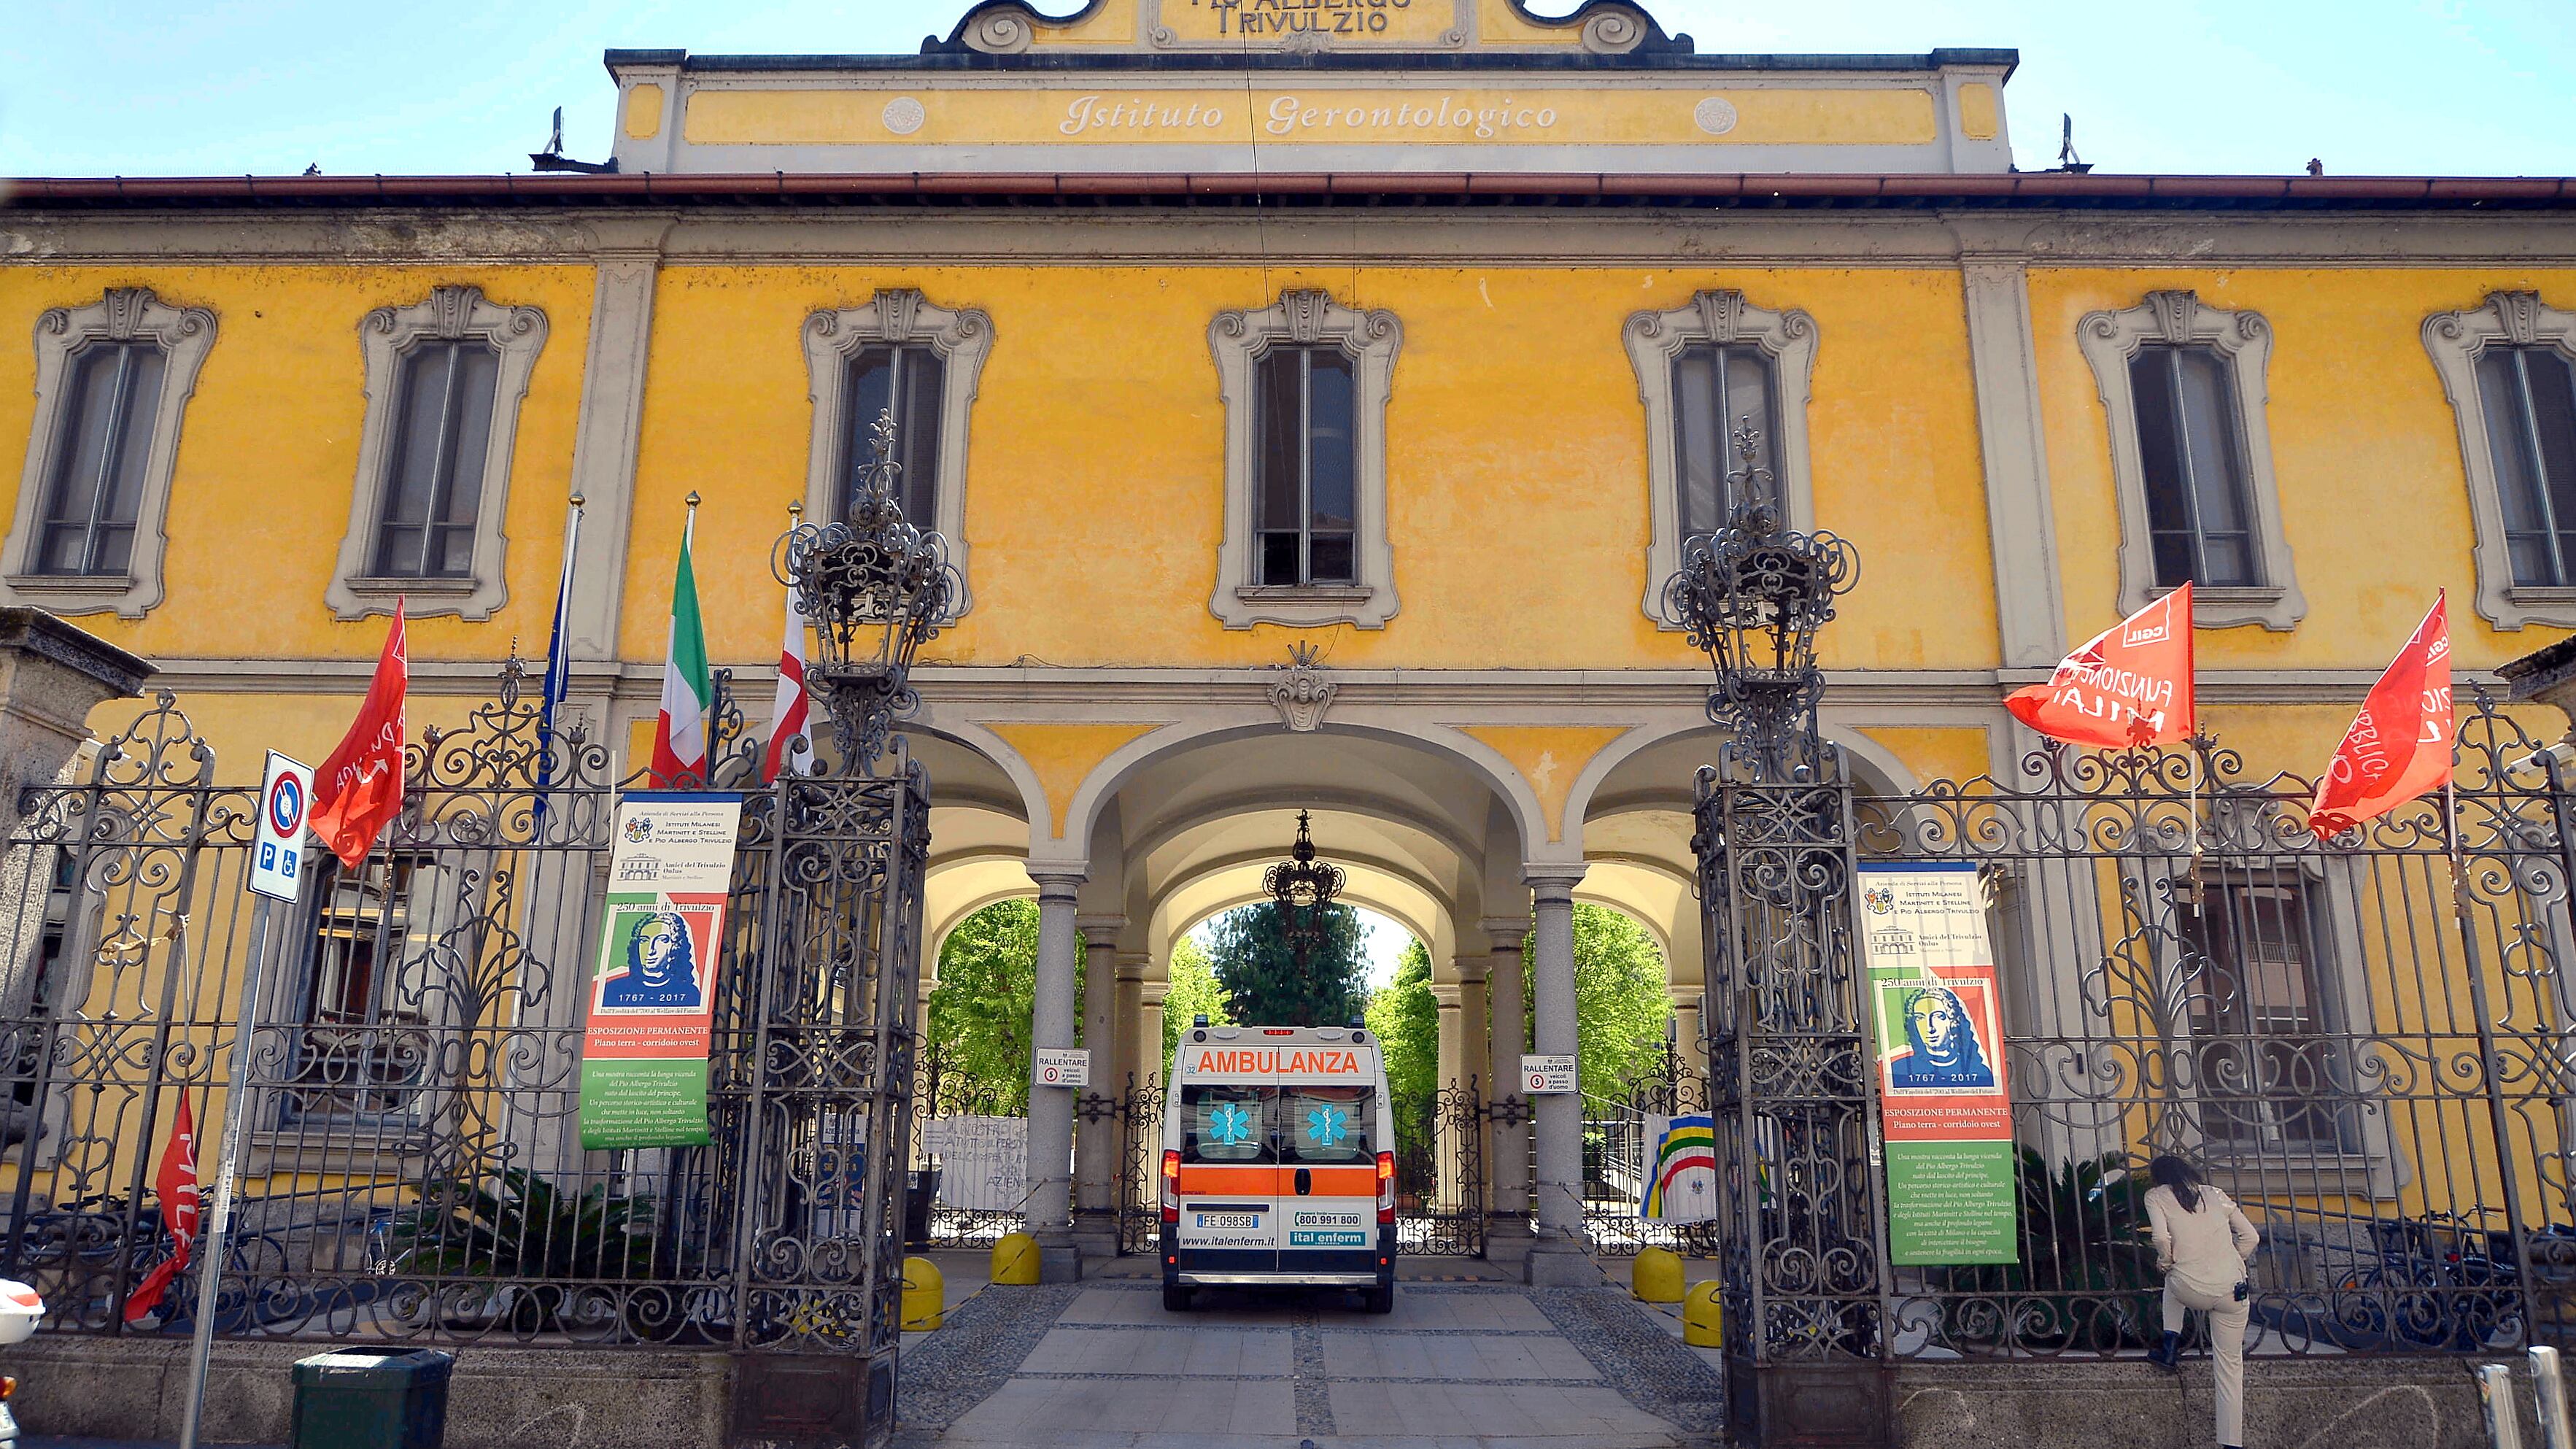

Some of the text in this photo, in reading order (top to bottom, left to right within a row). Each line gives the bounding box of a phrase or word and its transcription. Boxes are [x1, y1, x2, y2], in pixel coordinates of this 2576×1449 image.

[1211, 6, 1387, 34] TRIVULZIO
[1059, 96, 1557, 138] Istituto Gerontologico
[616, 902, 714, 911] 250 anni di Trivulzio
[1881, 976, 1984, 986] 250 anni di Trivulzio
[619, 994, 644, 1002] 1767
[660, 994, 686, 1002] 2017
[647, 1027, 708, 1035] PERMANENTE
[1039, 1058, 1087, 1067] RALLENTARE
[1198, 1051, 1359, 1074] AMBULANZA
[1908, 1074, 1935, 1082] 1767
[1946, 1108, 2008, 1116] PERMANENTE
[1894, 1121, 1916, 1129] Piano
[1204, 1216, 1251, 1226] FE 098SB
[1300, 1216, 1358, 1224] 800 991 800
[1182, 1236, 1275, 1246] www.italenferm.it
[1294, 1233, 1361, 1242] ital enferm
